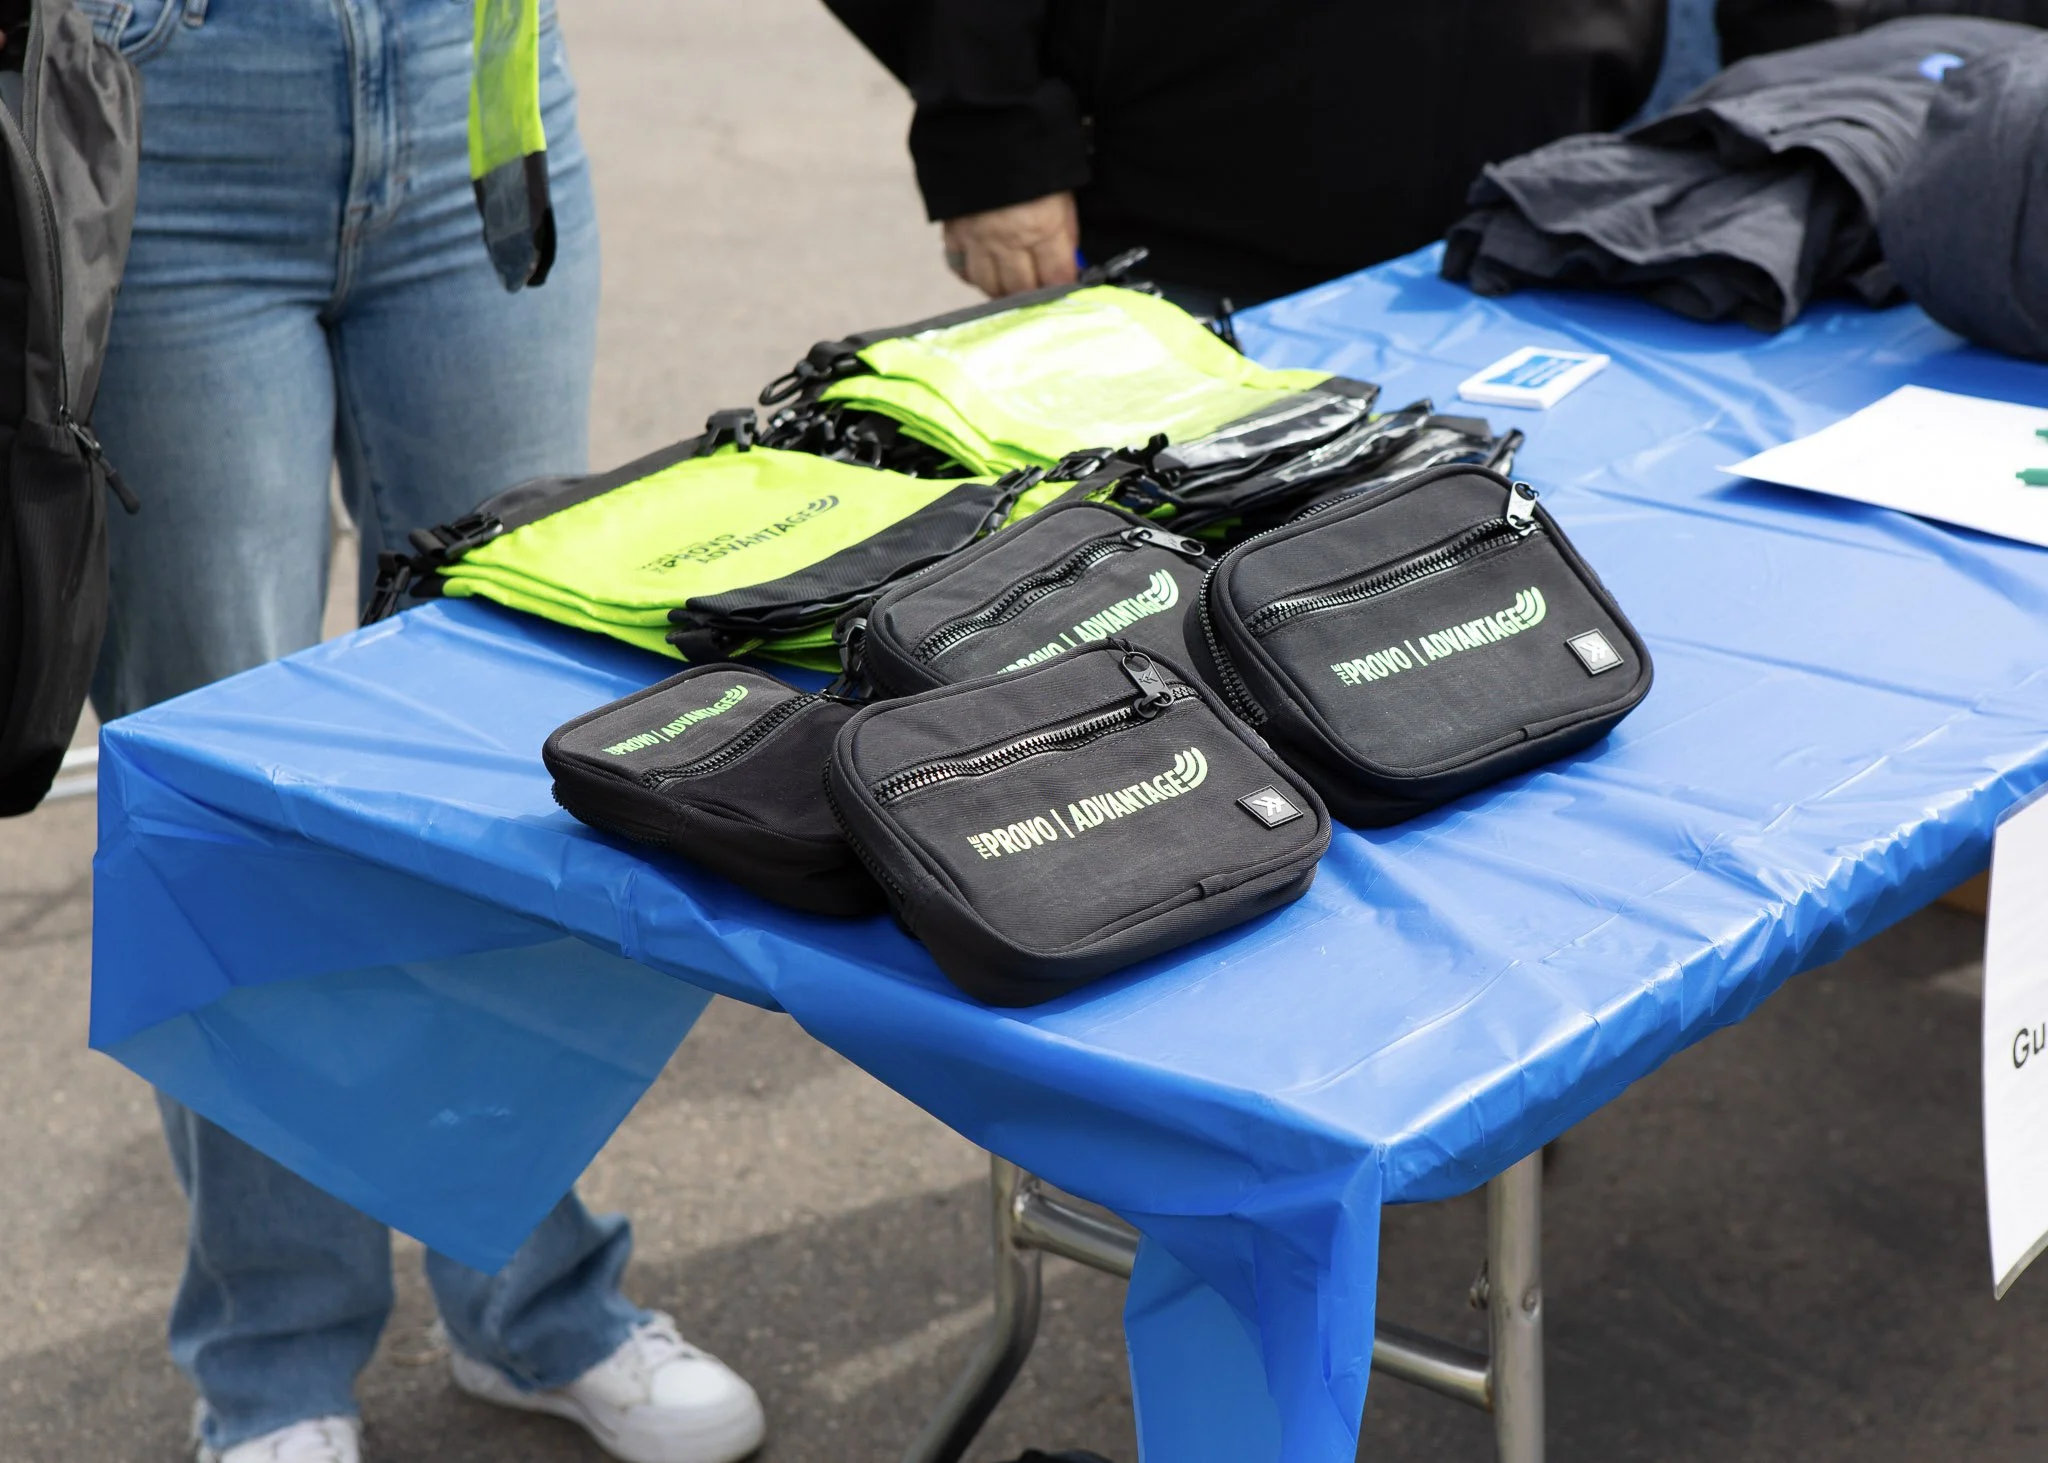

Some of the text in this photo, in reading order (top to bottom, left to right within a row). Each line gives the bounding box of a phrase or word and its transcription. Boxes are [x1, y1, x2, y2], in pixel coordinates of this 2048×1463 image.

[1073, 590, 1168, 643] ADVANTAGE
[1341, 646, 1413, 685] PROVO
[1418, 607, 1531, 661] ADVANTAGE
[661, 696, 739, 738] ADVANTAGE
[966, 769, 1192, 860] THE PROVO ADVANTAGE
